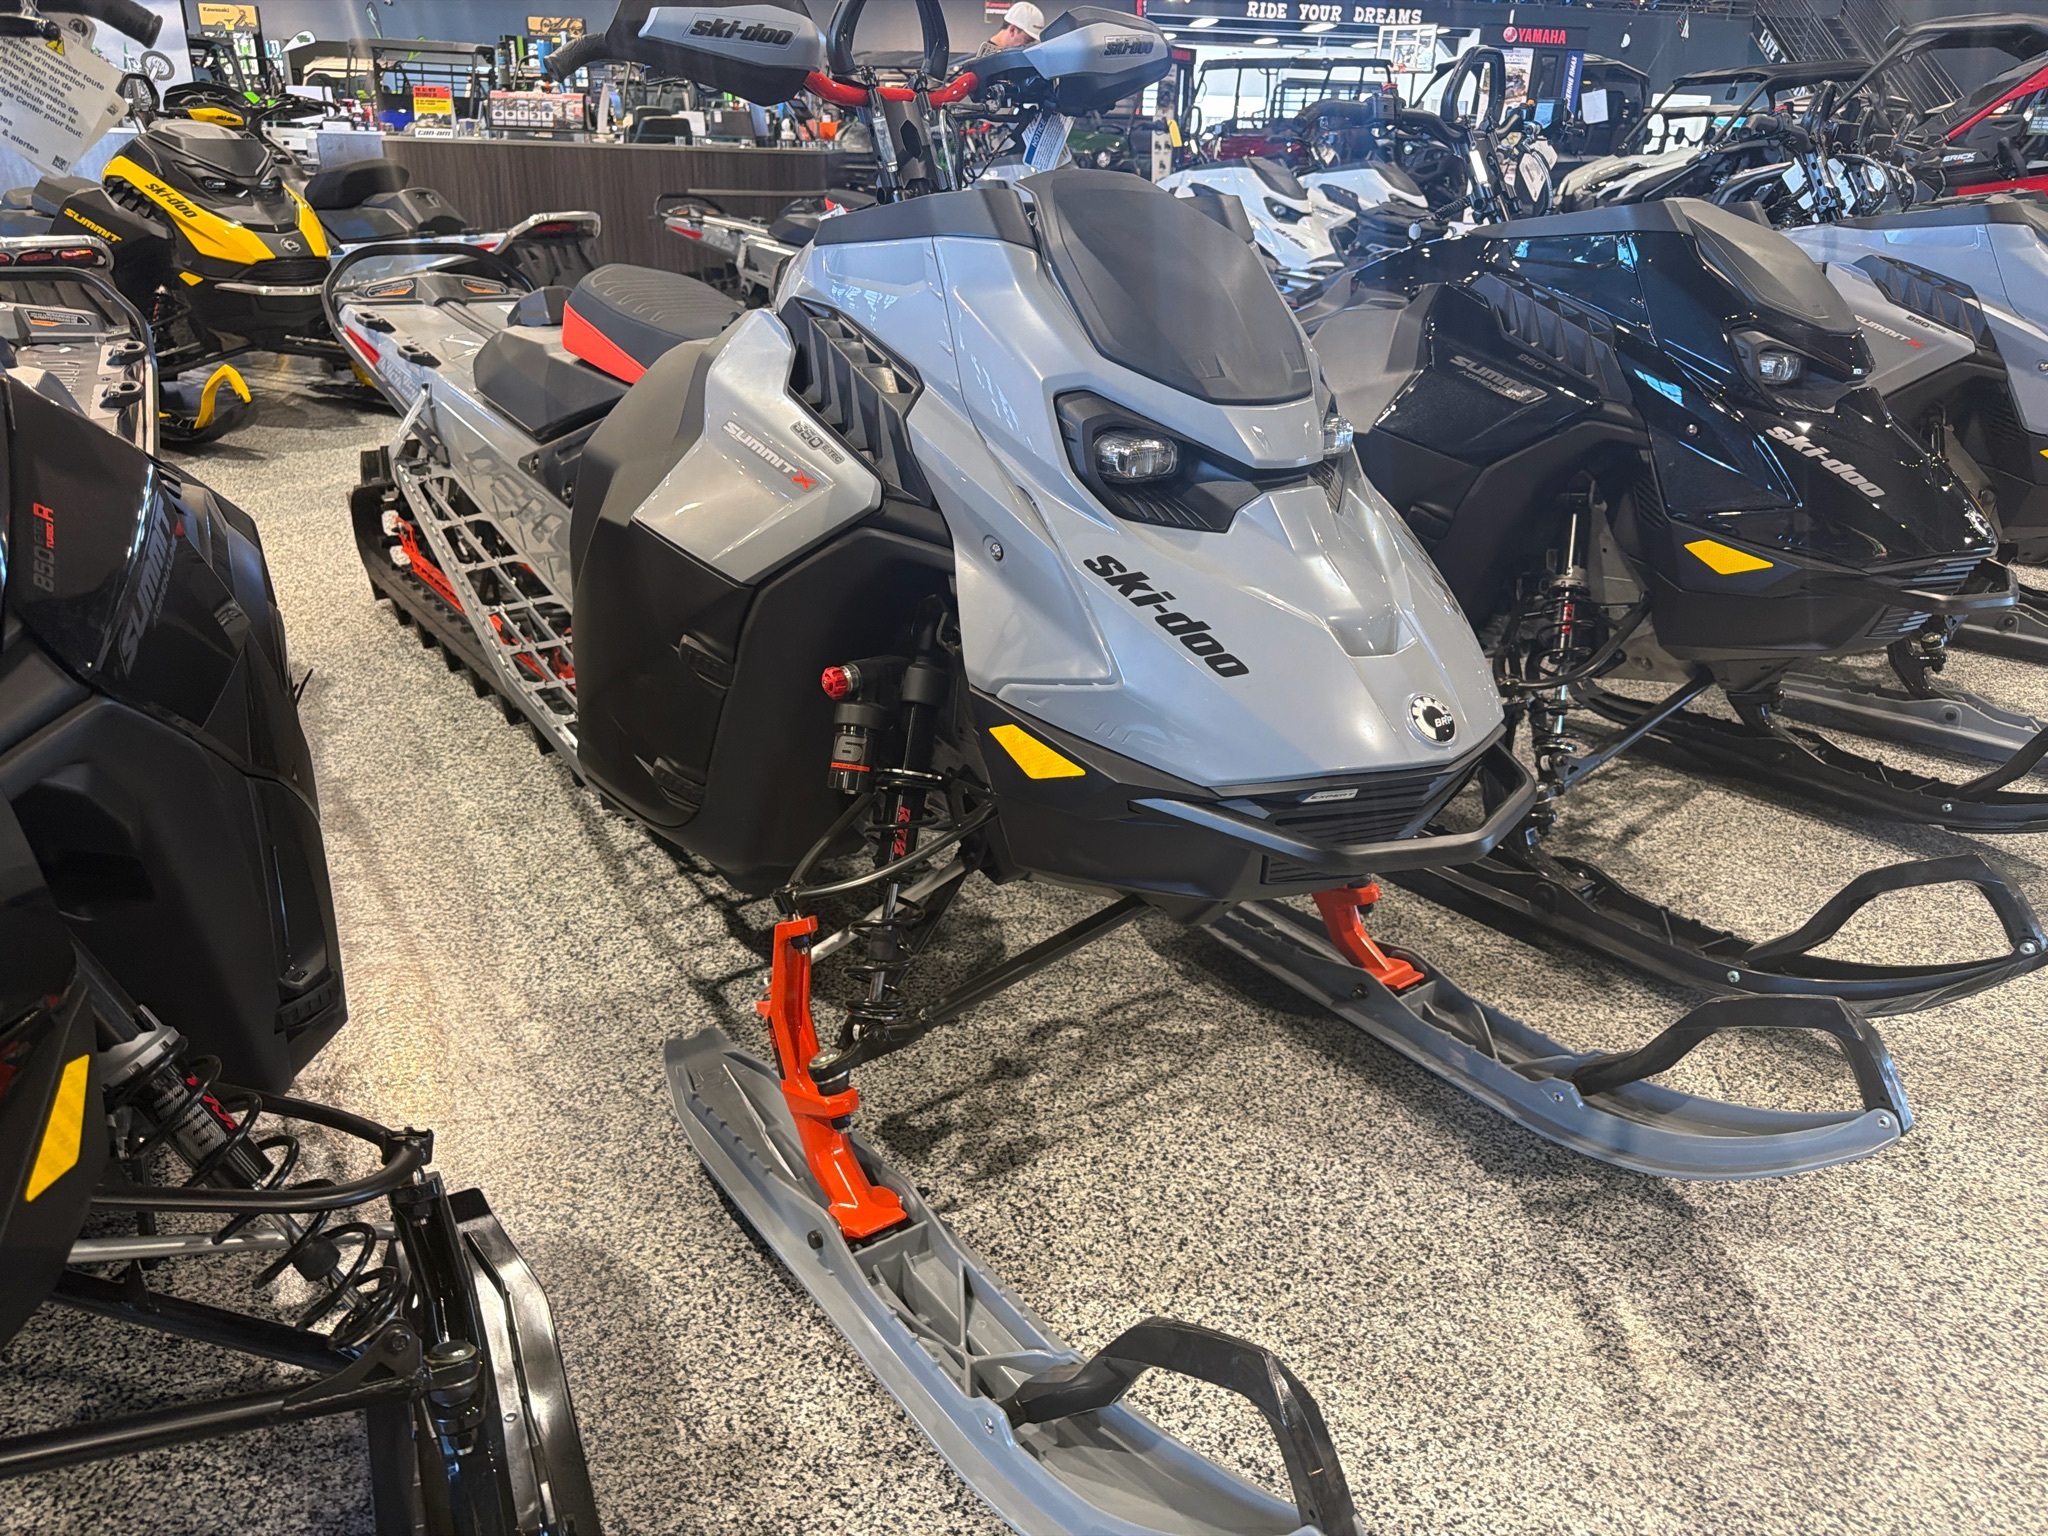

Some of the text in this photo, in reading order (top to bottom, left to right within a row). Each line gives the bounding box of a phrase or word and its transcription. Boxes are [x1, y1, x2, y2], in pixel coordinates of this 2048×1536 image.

[1247, 1, 1423, 25] RIDE YOUR DREAMS
[690, 18, 794, 45] ski-doo
[1518, 28, 1566, 44] YAMAHA
[1759, 29, 1779, 60] LIVE
[0, 37, 33, 58] cédure
[34, 56, 86, 91] d'inspection
[10, 50, 47, 78] livraison
[49, 74, 61, 85] ou
[61, 82, 73, 92] de
[32, 44, 82, 77] commencer
[83, 74, 105, 91] toute
[1569, 55, 1578, 77] RMAX
[21, 78, 79, 117] du numéro de
[28, 71, 48, 88] faire
[49, 85, 66, 98] une
[9, 81, 45, 107] véhicule
[45, 103, 67, 120] dans
[67, 113, 77, 125] le
[16, 95, 85, 140] Center pour tout:
[2, 128, 39, 155] & alertes
[1031, 119, 1047, 148] NOTICE
[145, 183, 199, 219] ski-doo
[63, 207, 123, 244] SUMMIT
[1905, 315, 1931, 328] 850
[1516, 353, 1546, 370] 850
[722, 420, 818, 490] SUMMIT X
[792, 420, 843, 464] 850 E-TEC
[1766, 426, 1886, 498] ski-doo
[33, 502, 54, 523] R
[45, 521, 55, 549] TURBO
[33, 545, 55, 593] 850
[119, 490, 171, 675] SUMMIT
[1083, 555, 1250, 678] ski-doo
[1434, 715, 1453, 728] BRP
[1310, 792, 1356, 800] EXPERT
